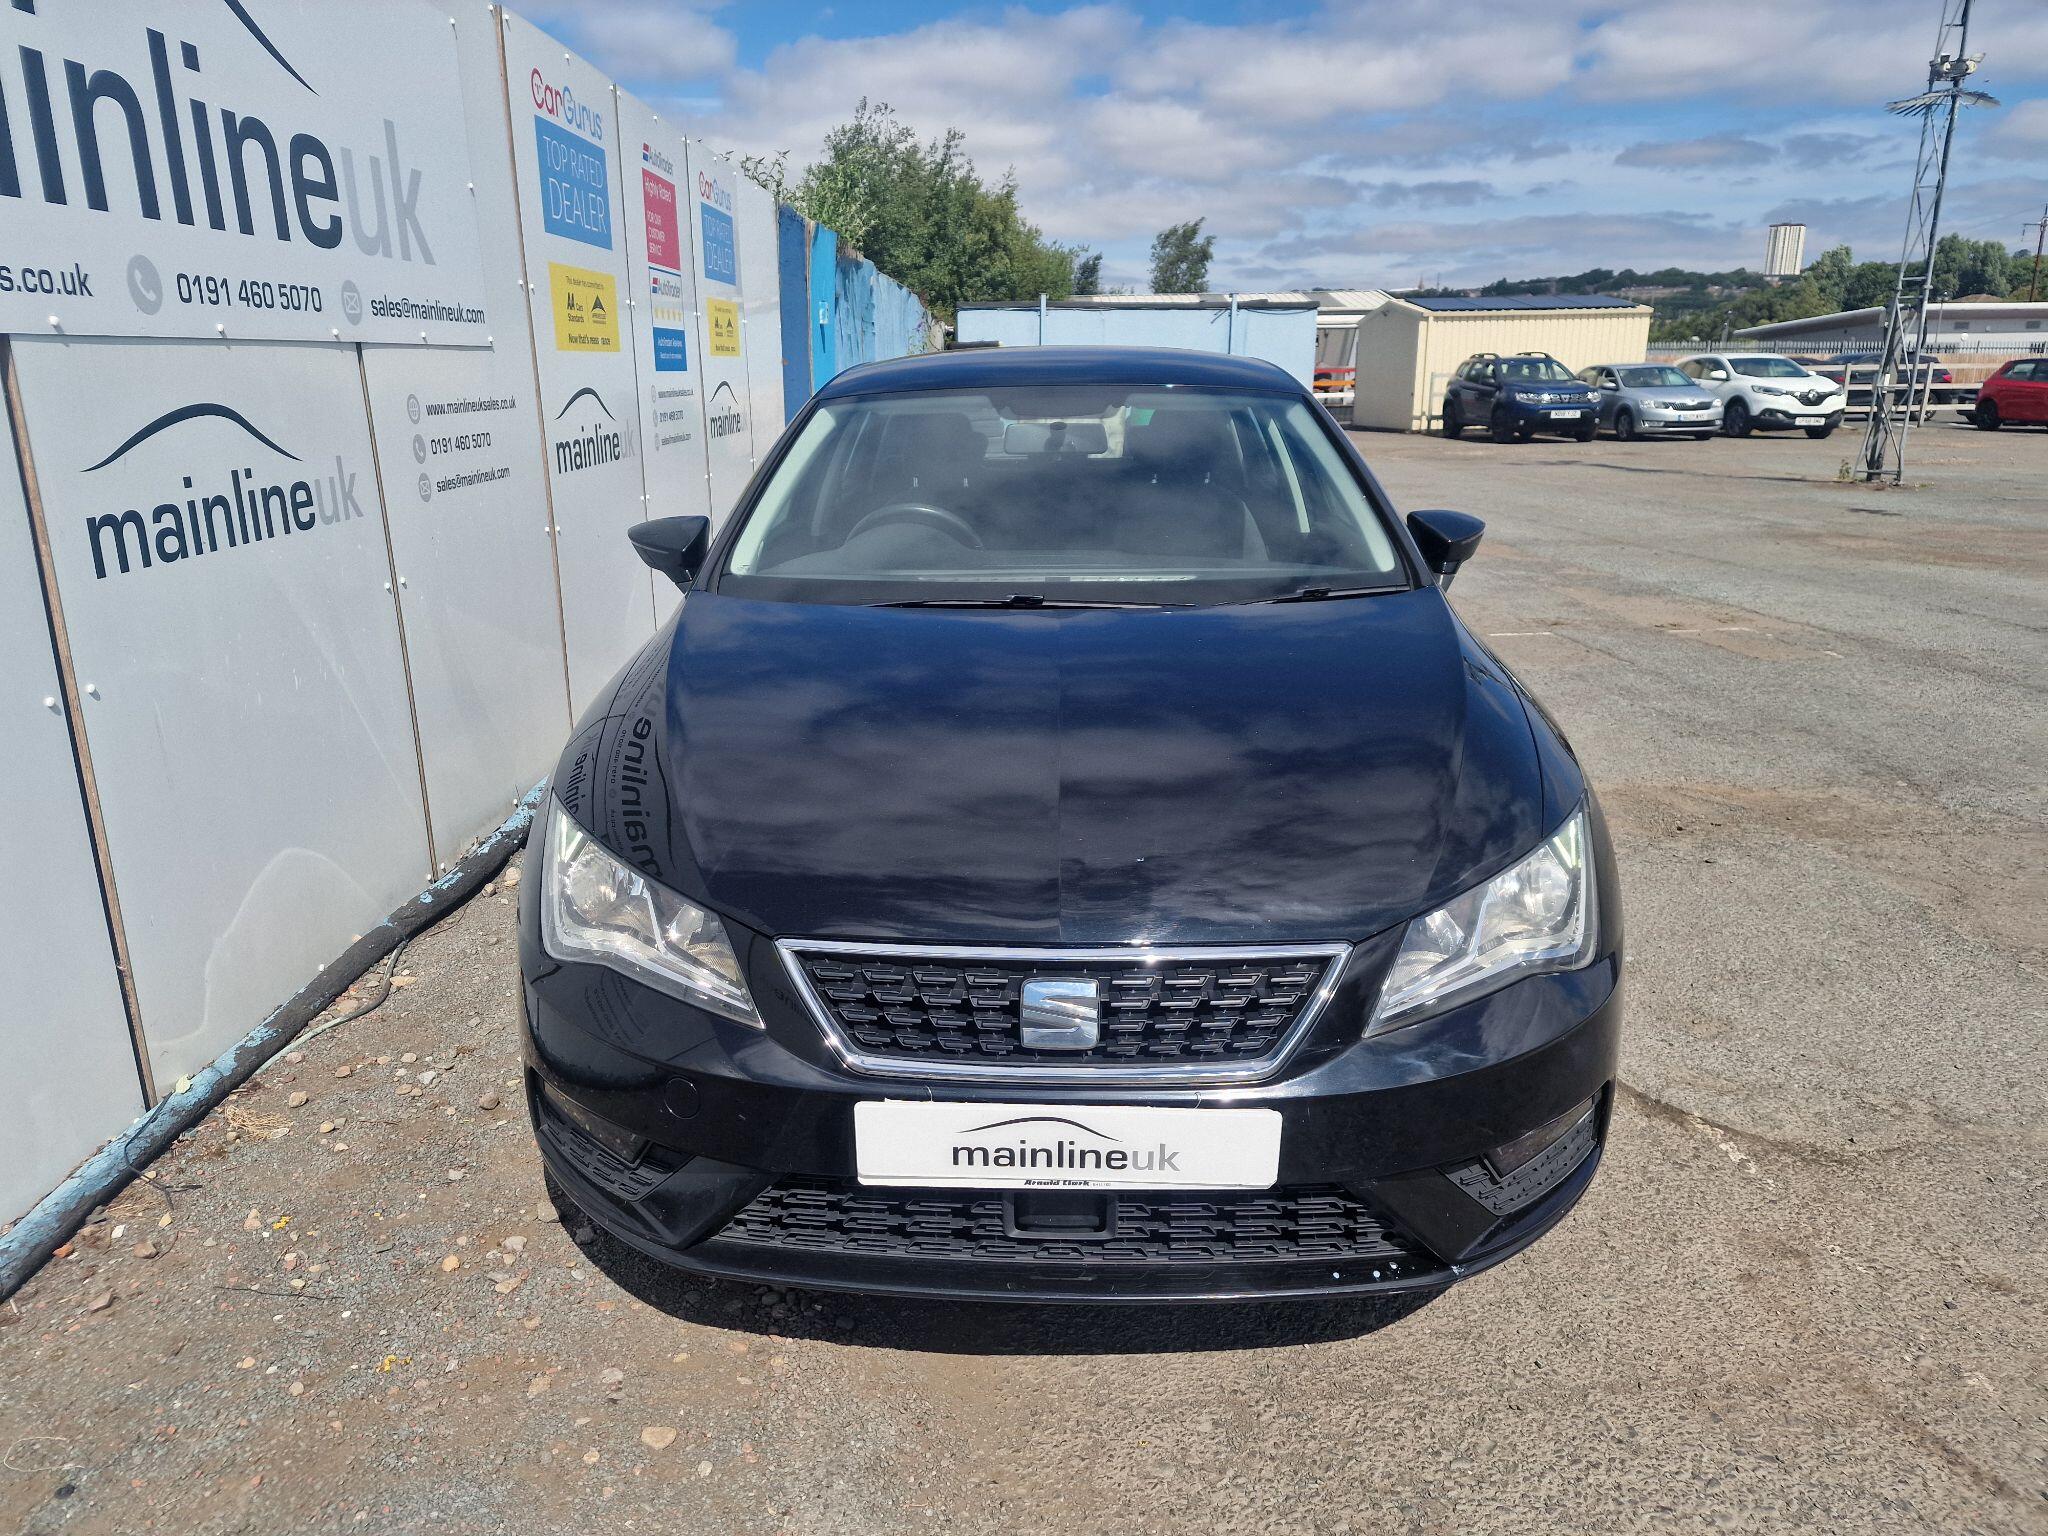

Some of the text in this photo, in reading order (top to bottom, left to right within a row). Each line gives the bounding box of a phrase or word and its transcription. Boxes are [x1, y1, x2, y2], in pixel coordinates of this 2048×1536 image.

[531, 68, 603, 141] CarGurus
[543, 135, 604, 188] TOP RATED
[549, 177, 607, 233] DEALER
[699, 170, 732, 211] CarGurus
[176, 272, 323, 313] 0191 460 5070
[370, 294, 485, 324] sales@mainlineuk.com
[431, 432, 491, 454] 0191 460 5070
[556, 419, 635, 474] mainlineuk
[436, 467, 510, 492] sales@mainlineuk.com
[86, 455, 363, 579] mainlineuk
[952, 1138, 1182, 1172] mainlineuk
